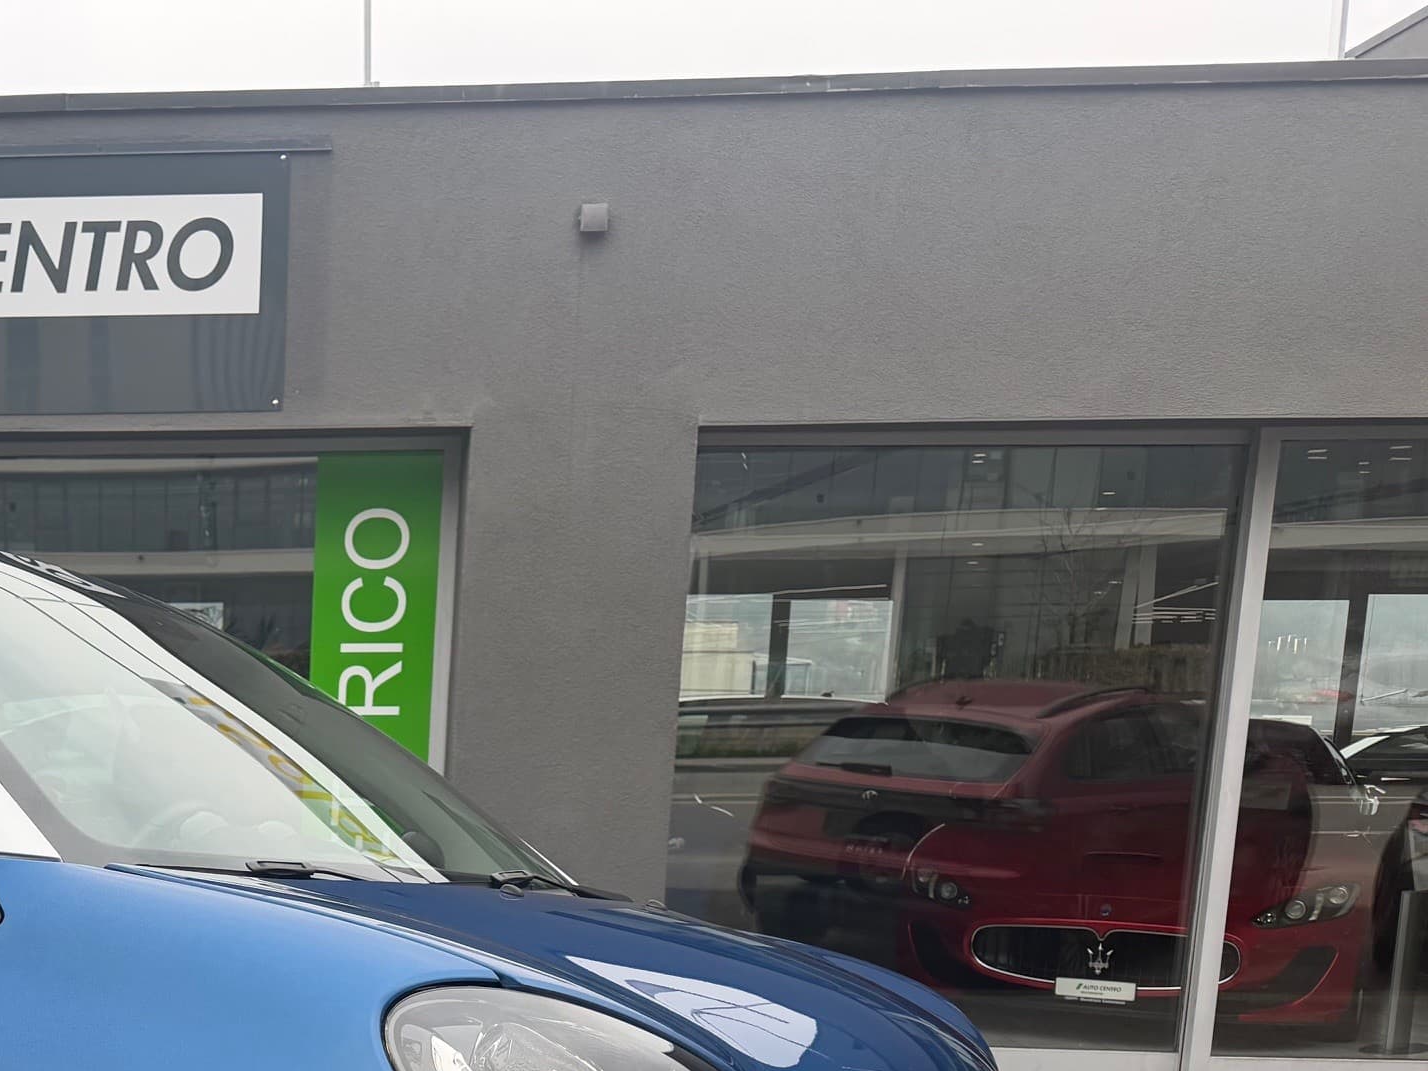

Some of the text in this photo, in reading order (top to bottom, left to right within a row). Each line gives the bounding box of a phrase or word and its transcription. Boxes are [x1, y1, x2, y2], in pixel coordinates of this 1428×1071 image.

[337, 507, 411, 717] RICO
[1082, 983, 1099, 991] AUTO
[1099, 984, 1122, 993] CENTRO
